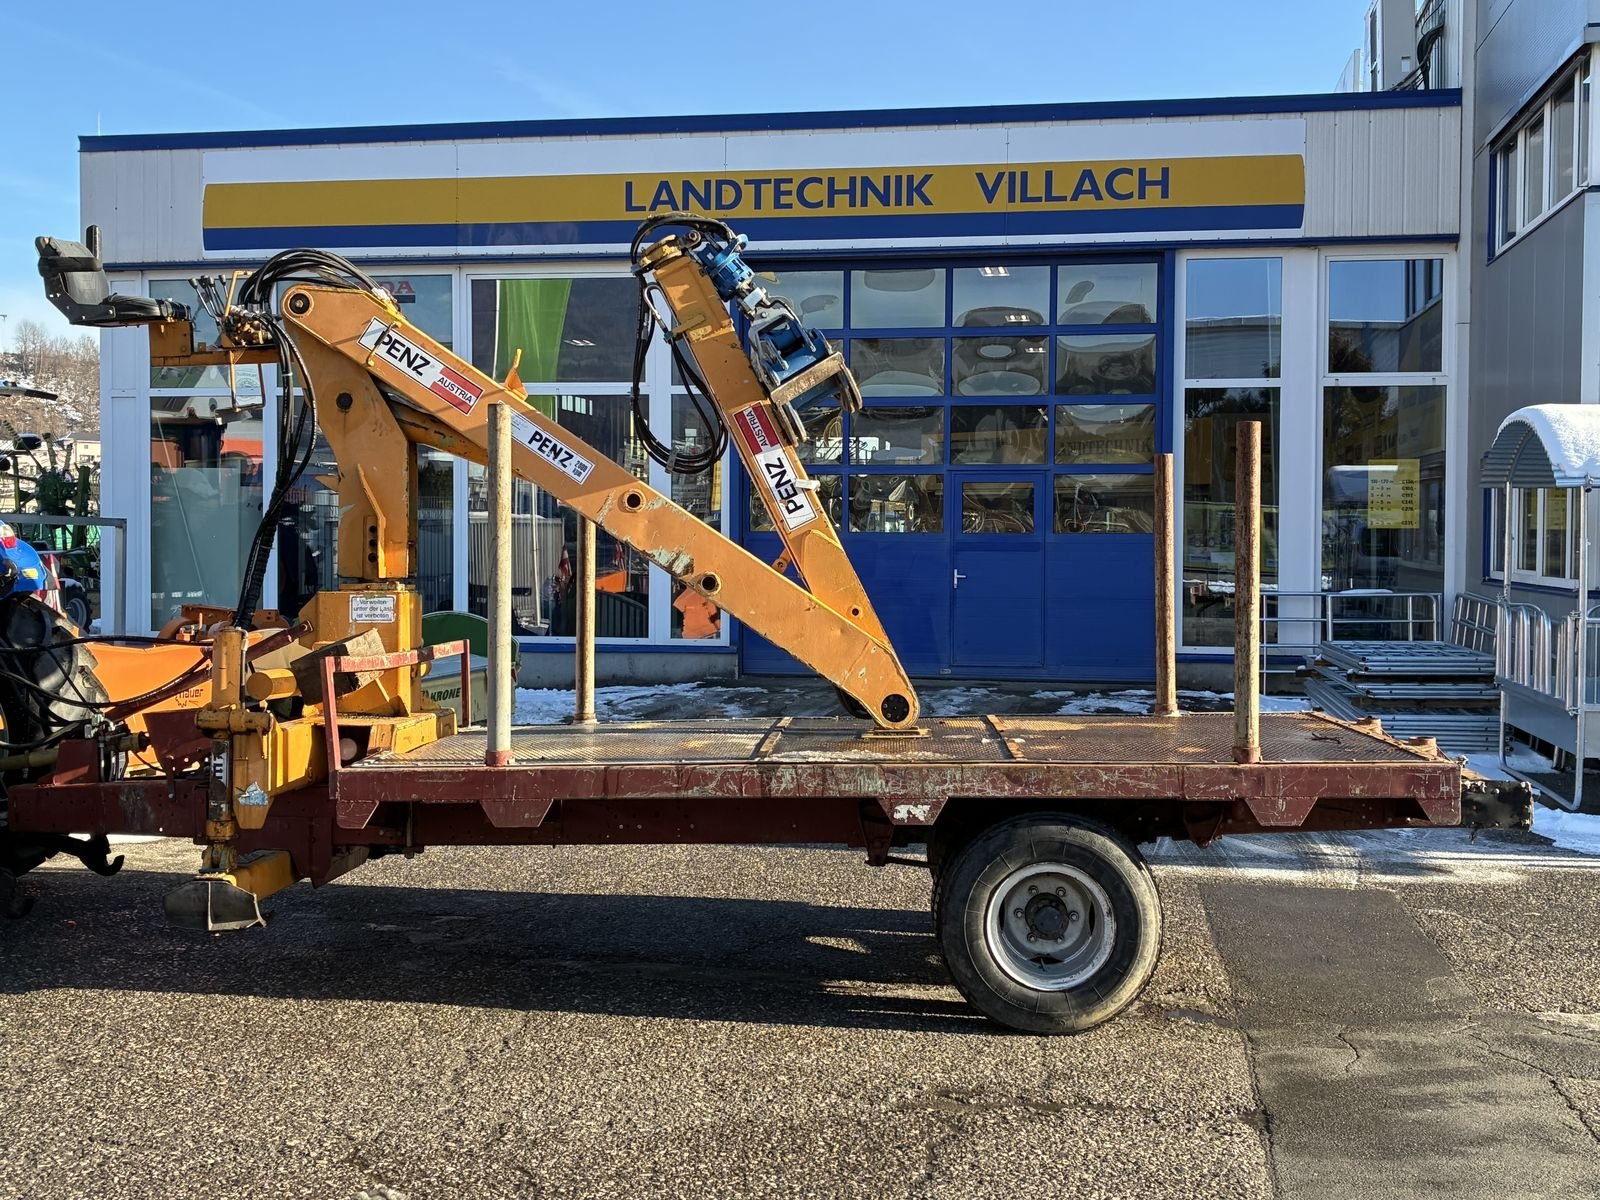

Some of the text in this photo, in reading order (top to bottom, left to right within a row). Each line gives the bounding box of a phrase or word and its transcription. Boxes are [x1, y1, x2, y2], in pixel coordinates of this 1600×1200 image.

[625, 167, 1170, 212] LANDTECHNIK VILLACH
[375, 330, 473, 404] PENZ AUSTRIA
[528, 430, 574, 468] PENZ
[746, 410, 804, 515] PENZ AUSTRIA
[430, 687, 462, 702] KRONE
